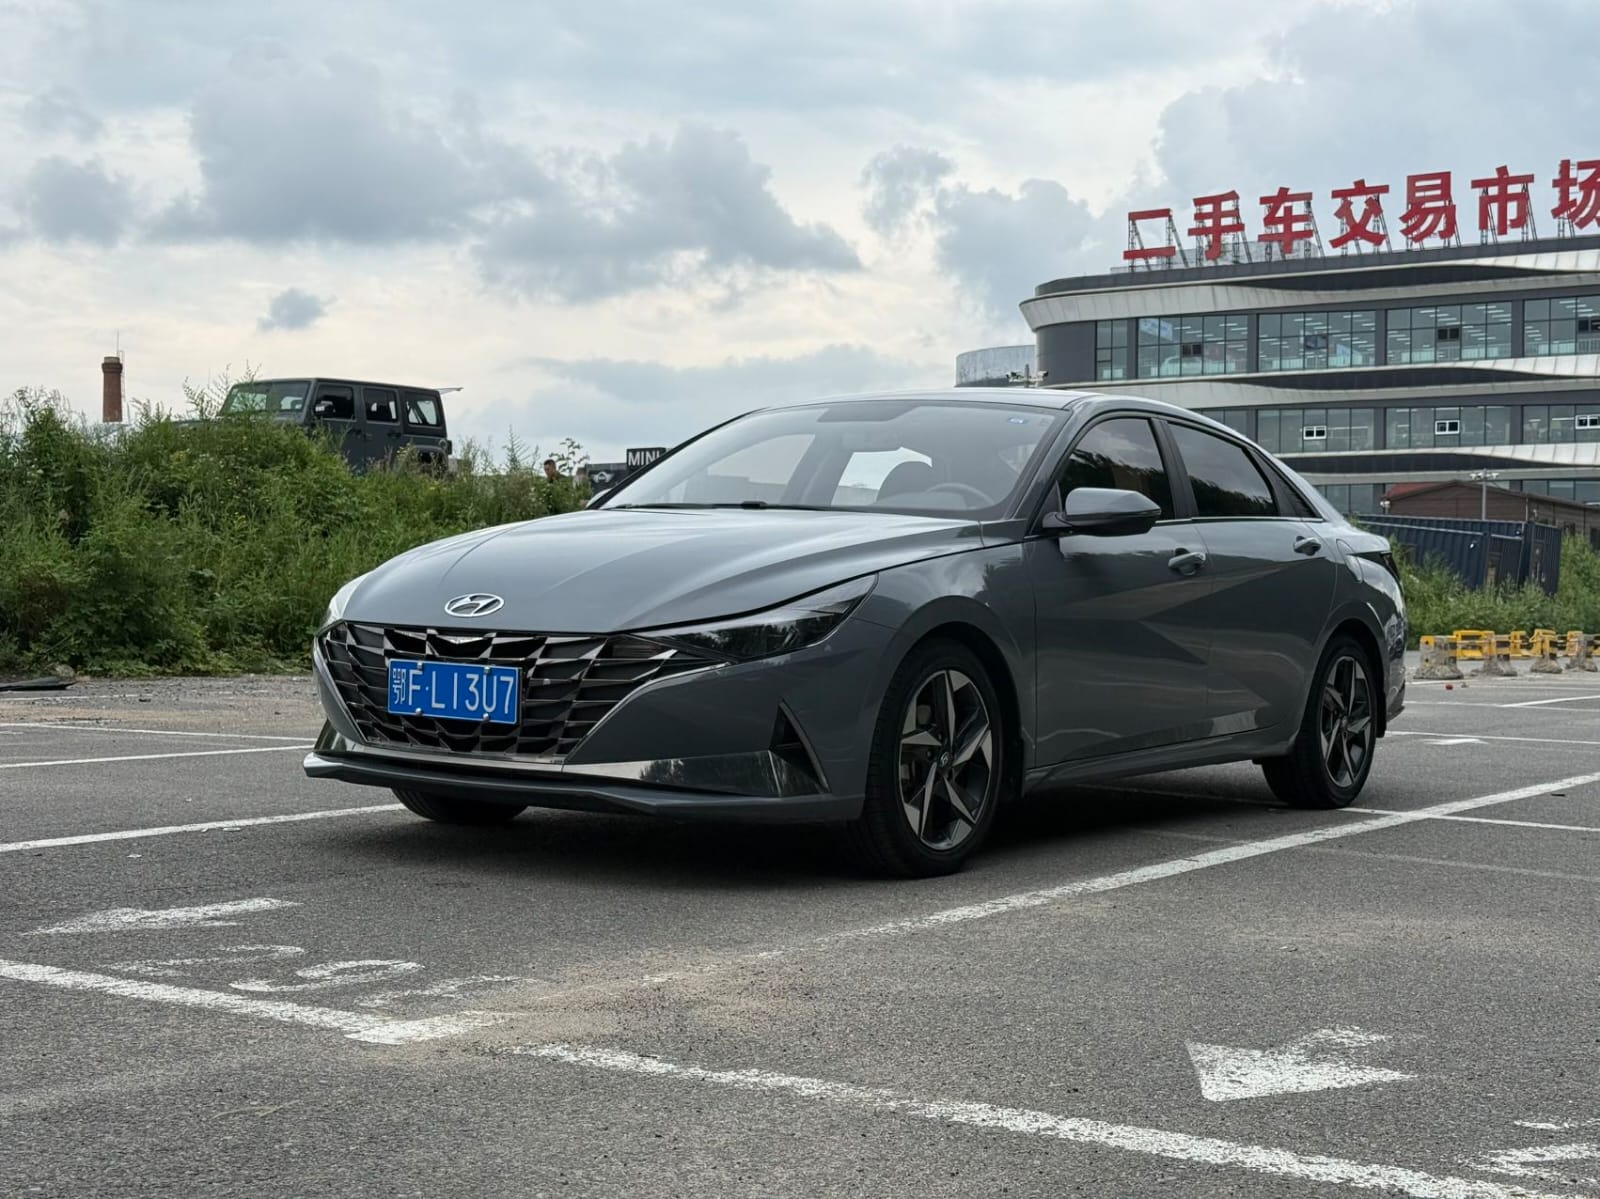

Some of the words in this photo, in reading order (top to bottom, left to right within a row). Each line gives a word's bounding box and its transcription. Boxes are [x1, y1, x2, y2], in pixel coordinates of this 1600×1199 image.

[1123, 159, 1600, 260] 二手车交易市场
